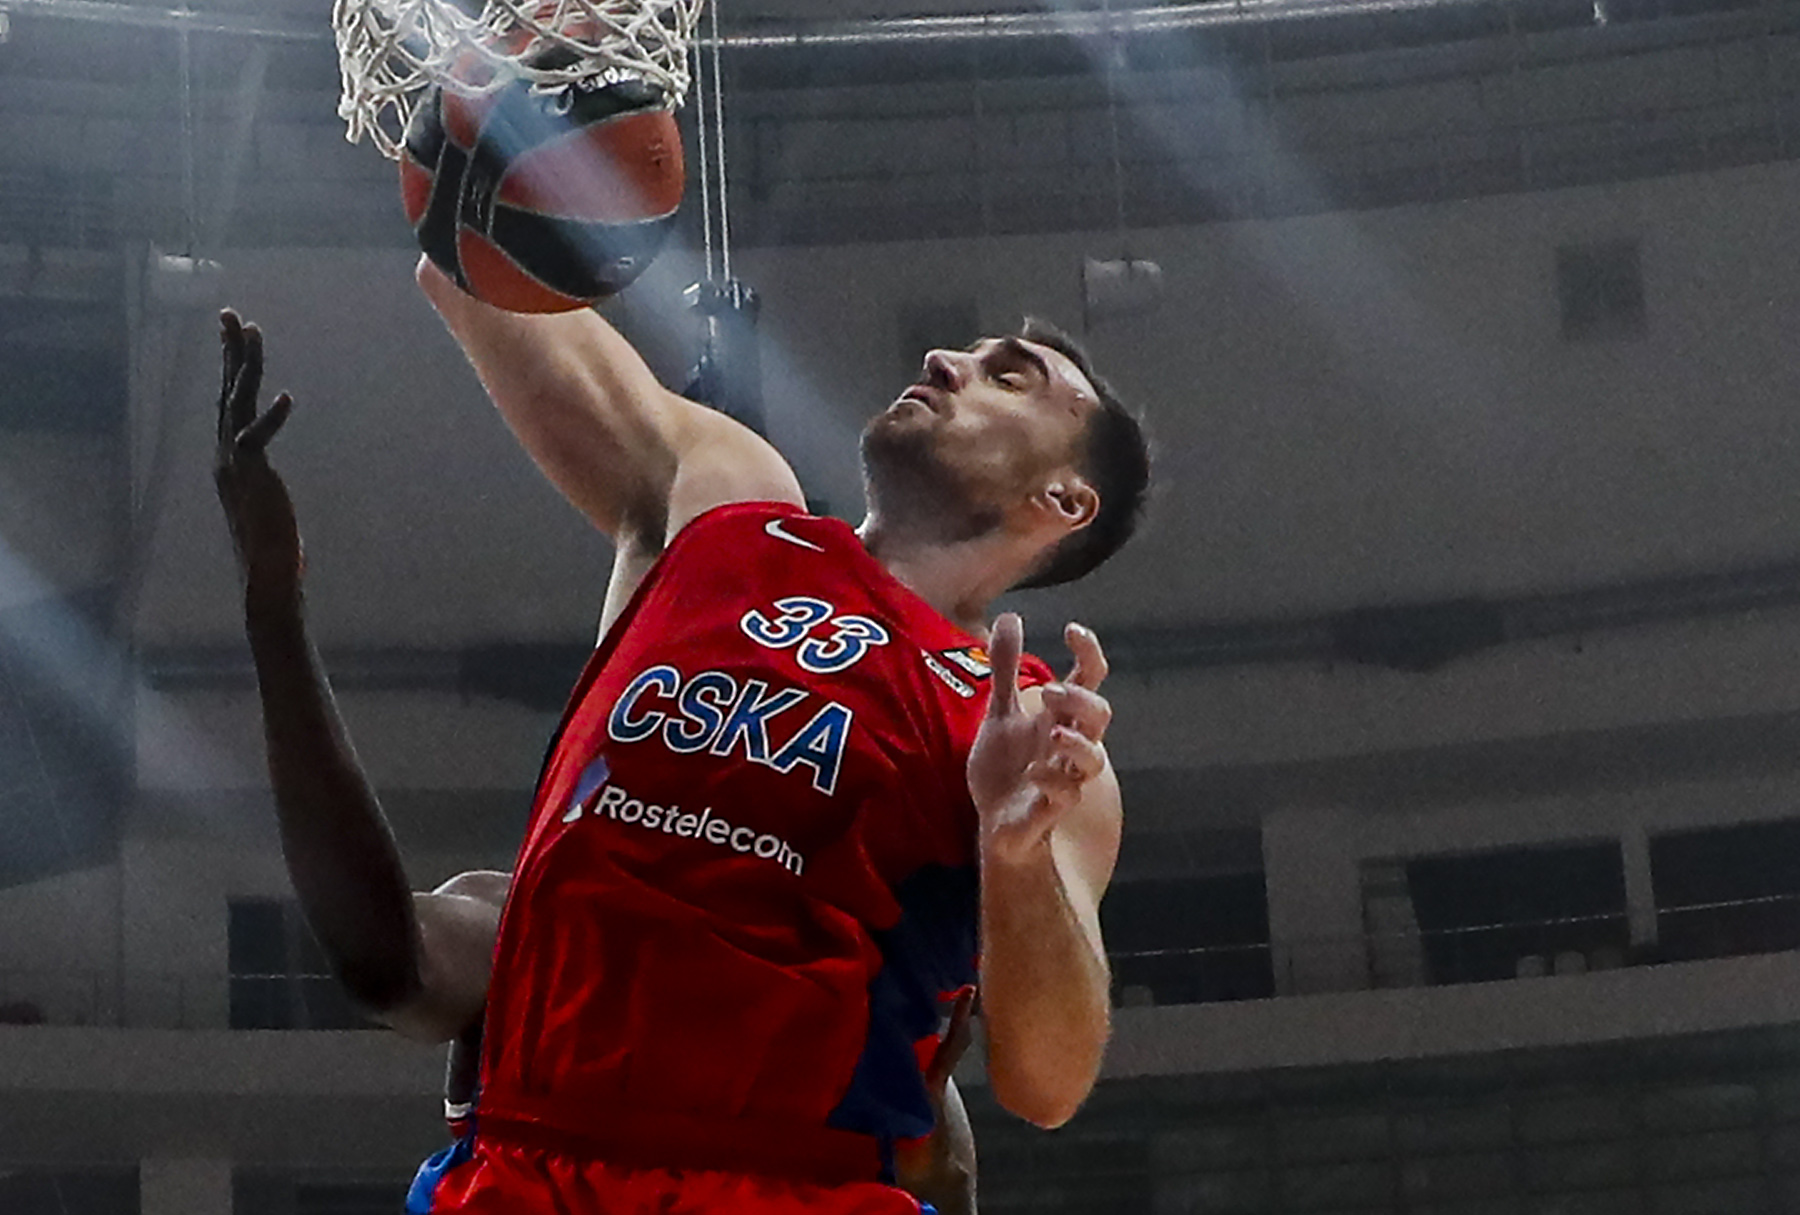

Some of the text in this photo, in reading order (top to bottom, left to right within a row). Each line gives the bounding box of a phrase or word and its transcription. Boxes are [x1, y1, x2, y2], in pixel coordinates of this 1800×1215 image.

[740, 596, 890, 673] 33
[607, 665, 853, 796] CSKA
[594, 785, 804, 875] Rostelecom
